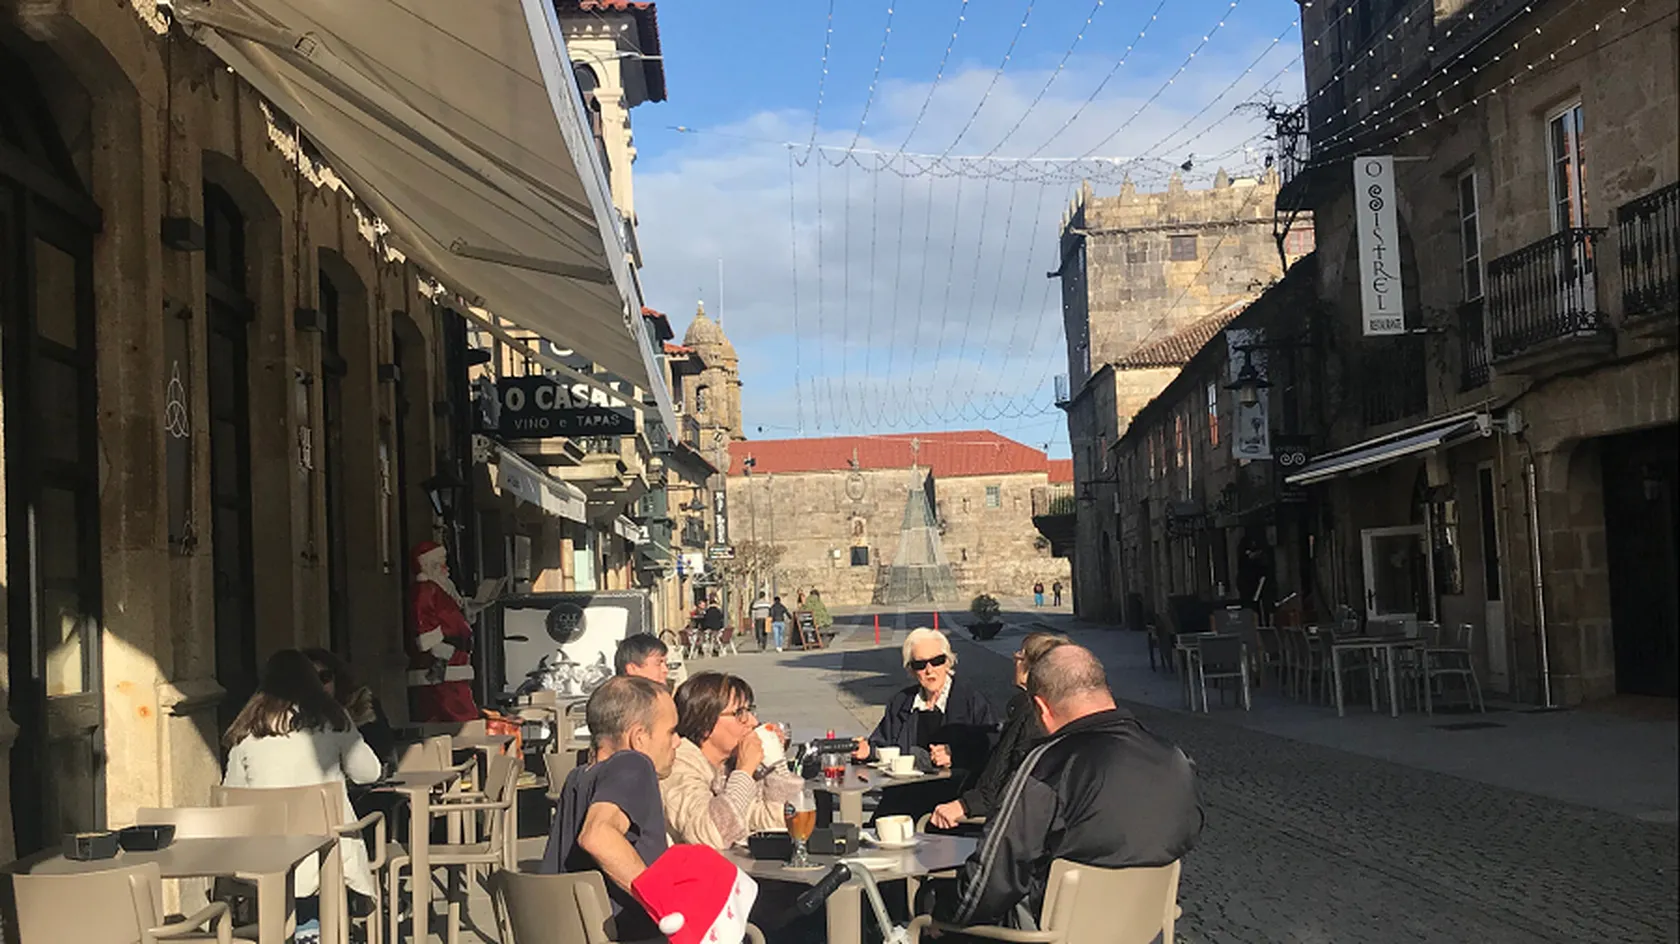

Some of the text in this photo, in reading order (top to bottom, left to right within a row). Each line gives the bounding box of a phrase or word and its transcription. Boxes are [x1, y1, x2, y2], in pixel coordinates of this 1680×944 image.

[505, 381, 628, 412] O CASAL
[559, 420, 568, 428] e
[576, 413, 620, 427] TAPAS
